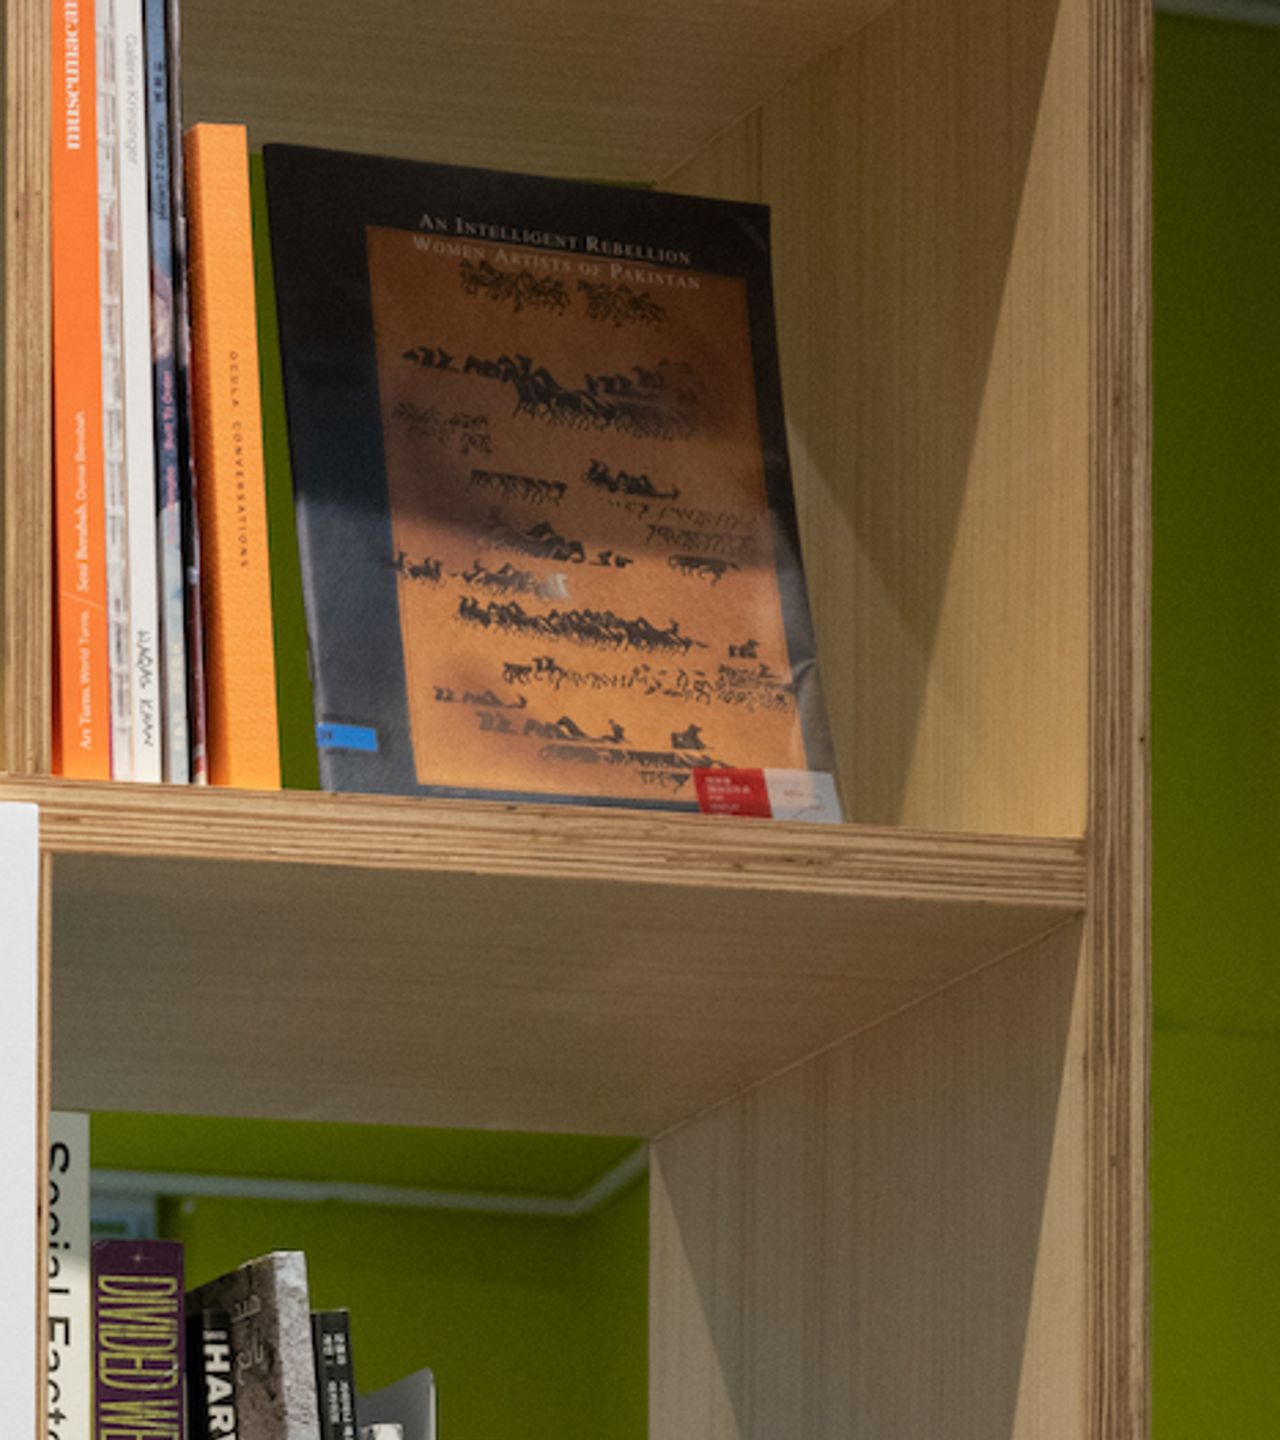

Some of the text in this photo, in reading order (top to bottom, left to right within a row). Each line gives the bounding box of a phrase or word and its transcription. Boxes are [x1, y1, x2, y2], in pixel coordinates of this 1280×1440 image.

[413, 236, 488, 261] WOMEN
[494, 248, 573, 272] ARTISTS
[609, 263, 702, 291] PAKISTAN
[419, 213, 691, 266] AN INTELLIGENT REBELLION
[96, 1273, 181, 1391] DIVIDED
